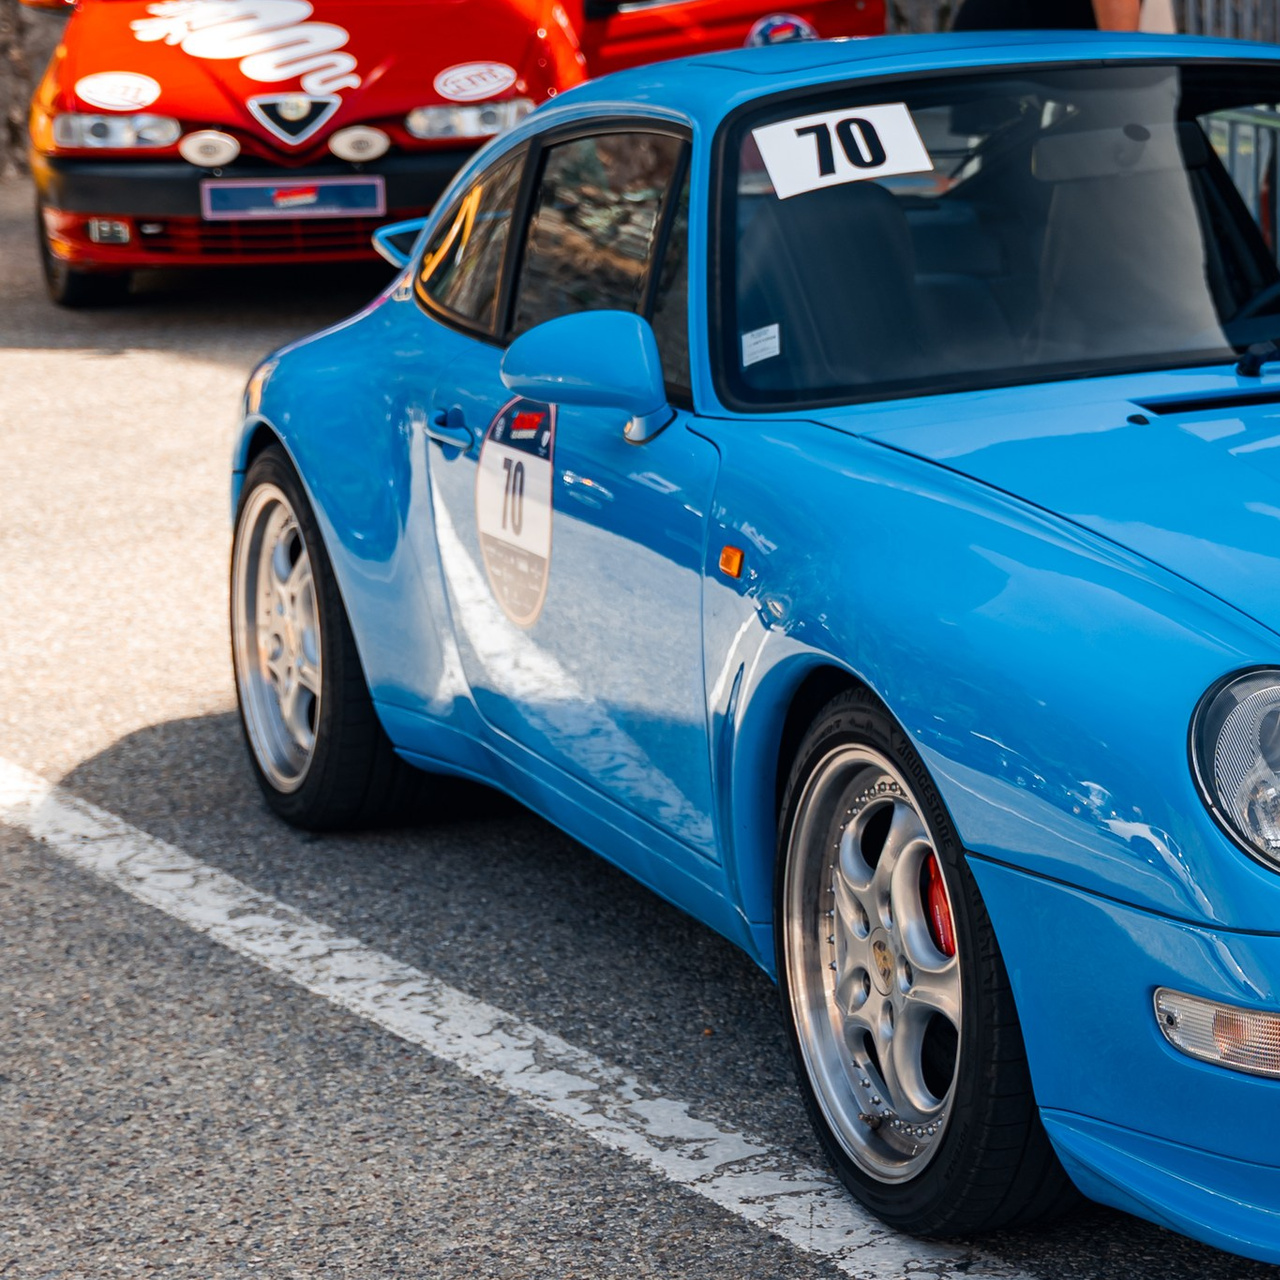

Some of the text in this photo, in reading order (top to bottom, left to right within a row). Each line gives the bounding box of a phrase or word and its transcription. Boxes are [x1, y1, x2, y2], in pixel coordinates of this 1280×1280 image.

[795, 117, 888, 178] 70
[501, 457, 524, 536] 70
[896, 739, 953, 849] BRIDGESTONE
